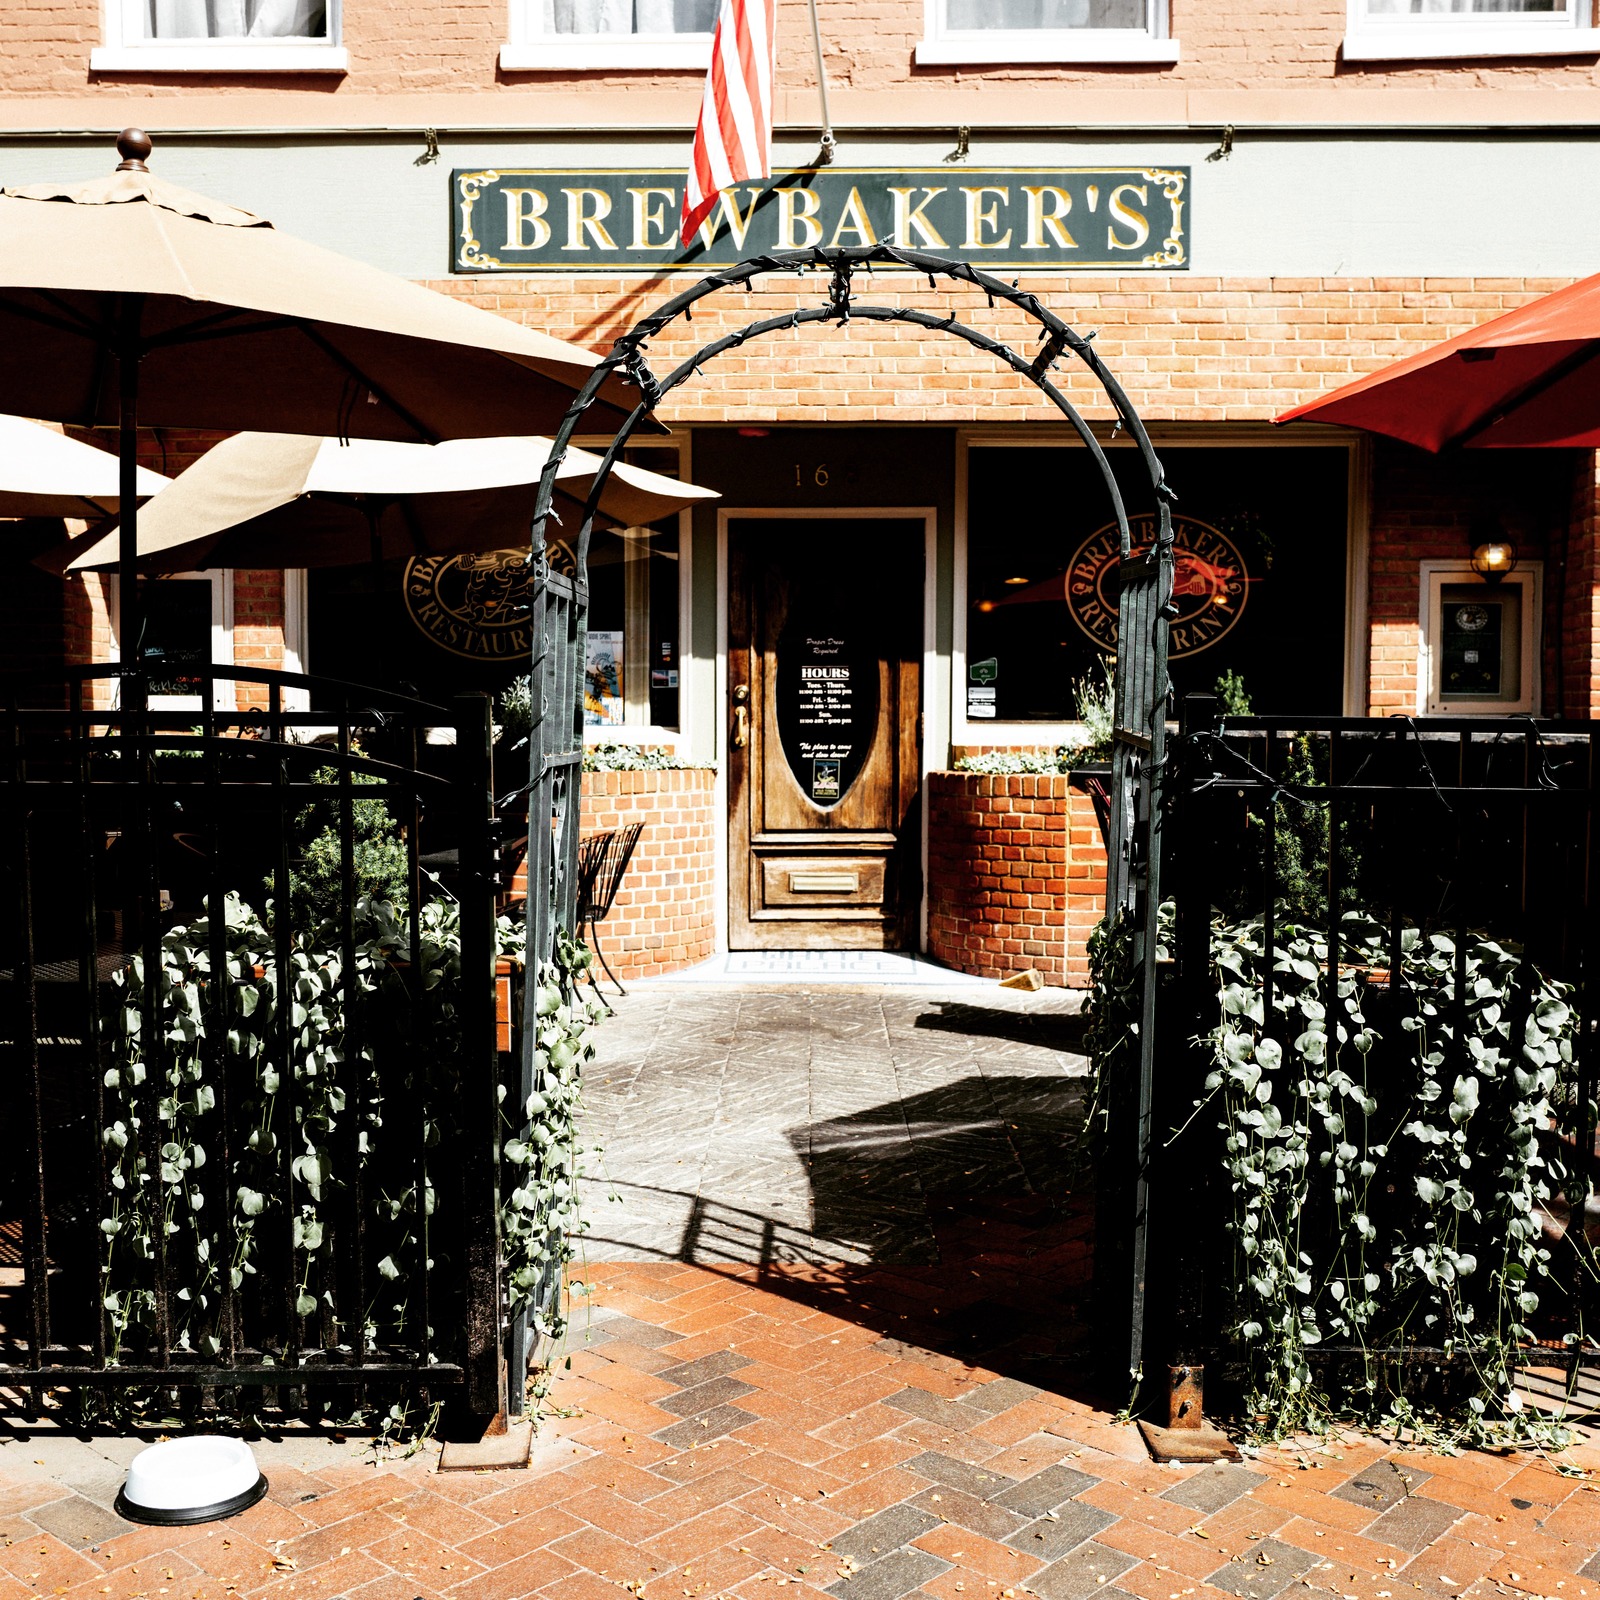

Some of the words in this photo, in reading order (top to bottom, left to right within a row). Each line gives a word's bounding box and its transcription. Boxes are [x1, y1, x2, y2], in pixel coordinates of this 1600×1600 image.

[501, 184, 1149, 251] BREWBAKER'S
[1074, 521, 1240, 582] BREBKER'S
[417, 600, 533, 654] RESTAUR
[1078, 600, 1236, 650] RESRANT
[801, 668, 850, 678] HOURS
[812, 647, 839, 656] Required
[812, 743, 829, 751] place
